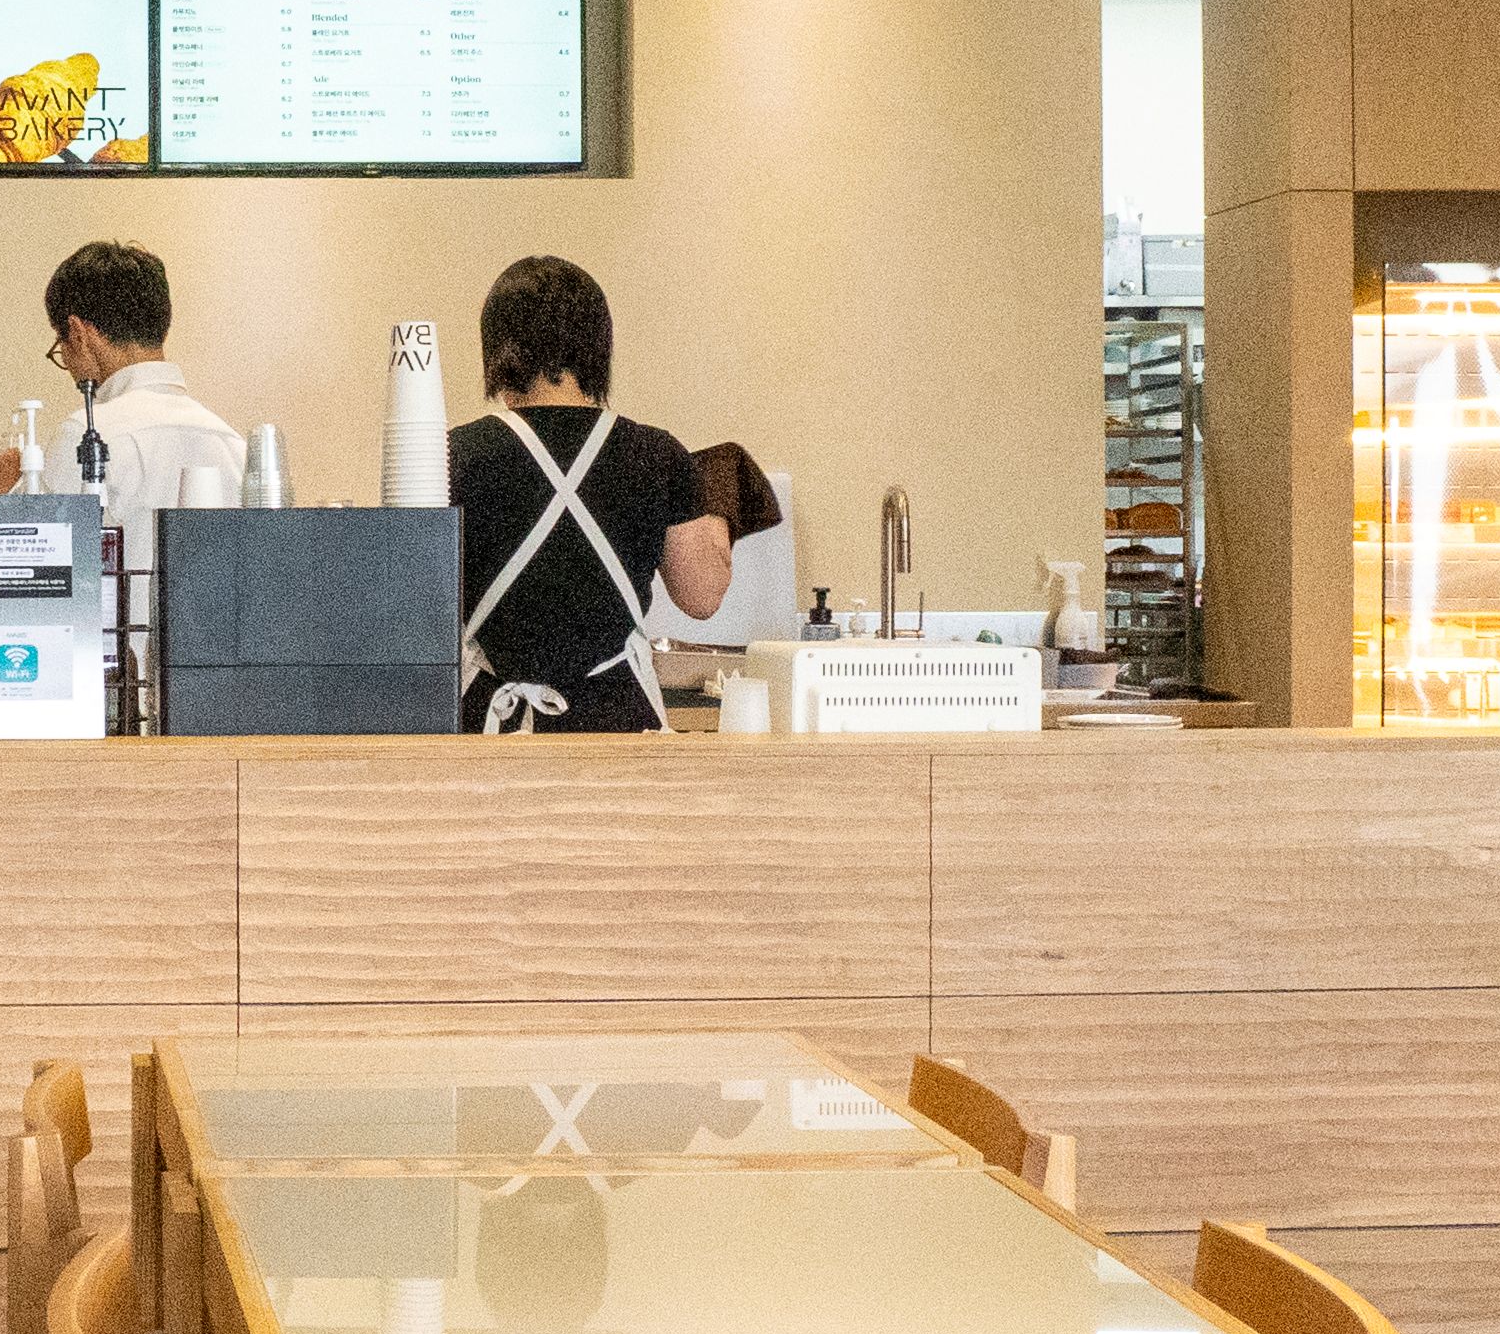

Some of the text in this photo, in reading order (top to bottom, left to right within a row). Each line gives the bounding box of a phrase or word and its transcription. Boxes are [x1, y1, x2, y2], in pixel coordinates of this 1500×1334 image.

[451, 75, 481, 85] Option
[0, 87, 126, 111] AVANT
[0, 117, 126, 141] BAKERY
